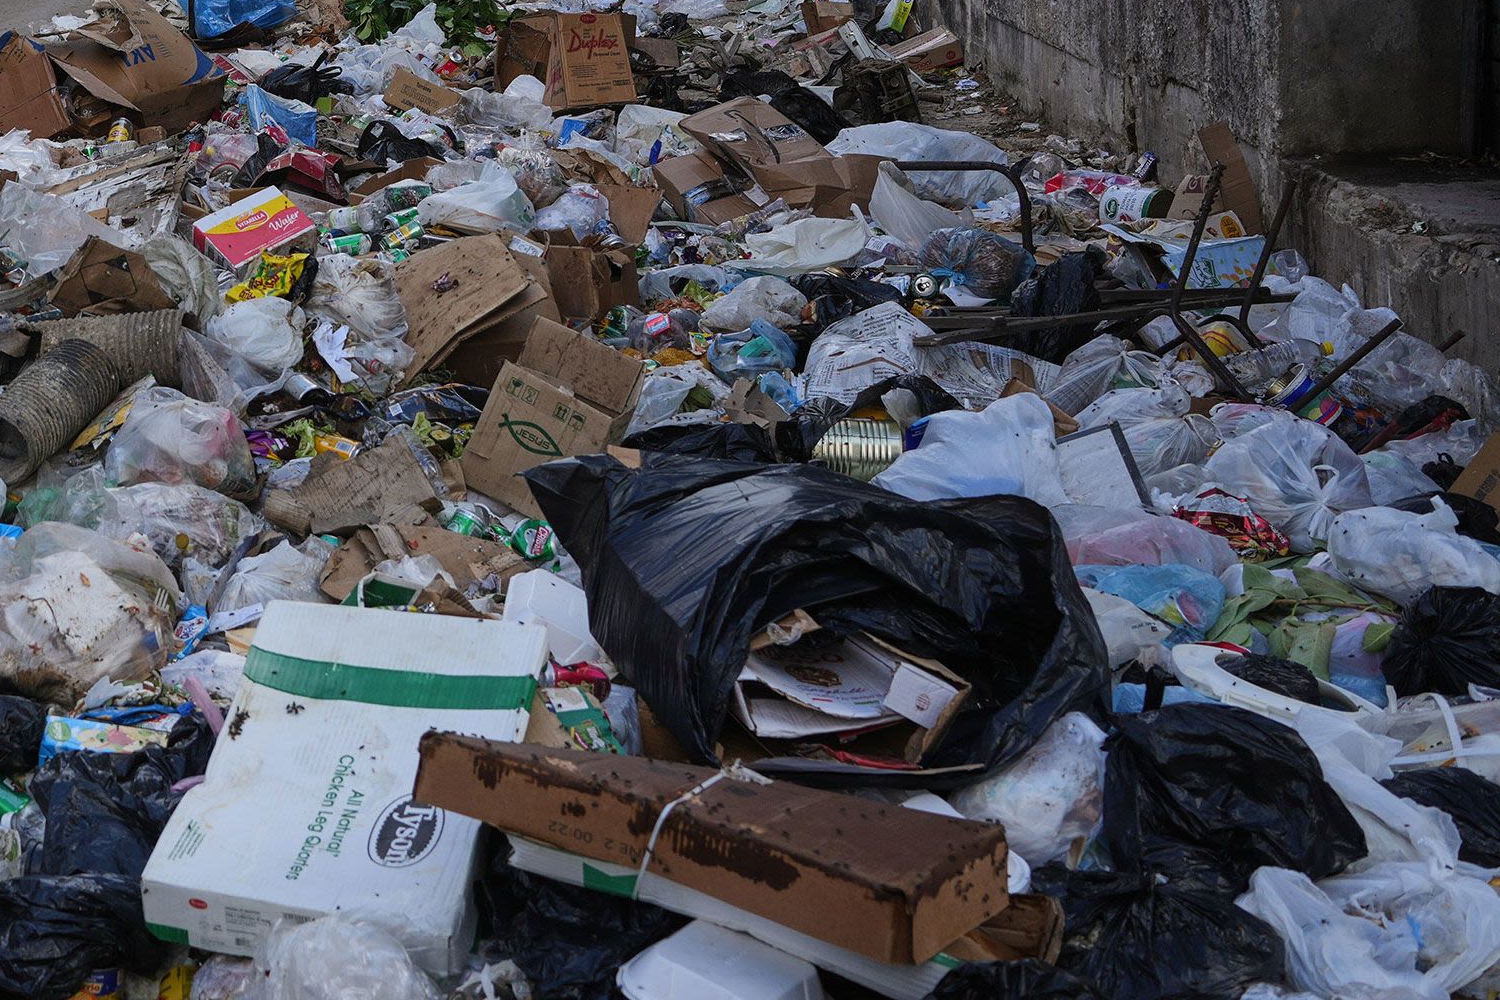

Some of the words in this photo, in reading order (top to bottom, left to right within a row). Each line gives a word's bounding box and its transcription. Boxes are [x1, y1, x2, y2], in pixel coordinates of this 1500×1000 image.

[568, 28, 619, 59] Duplex
[268, 211, 300, 231] Wafer
[514, 425, 552, 452] JESUS
[322, 754, 355, 808] Chicken
[344, 789, 365, 809] All
[308, 812, 328, 838] Leg
[383, 804, 435, 865] Tyson
[285, 835, 322, 881] Quarters
